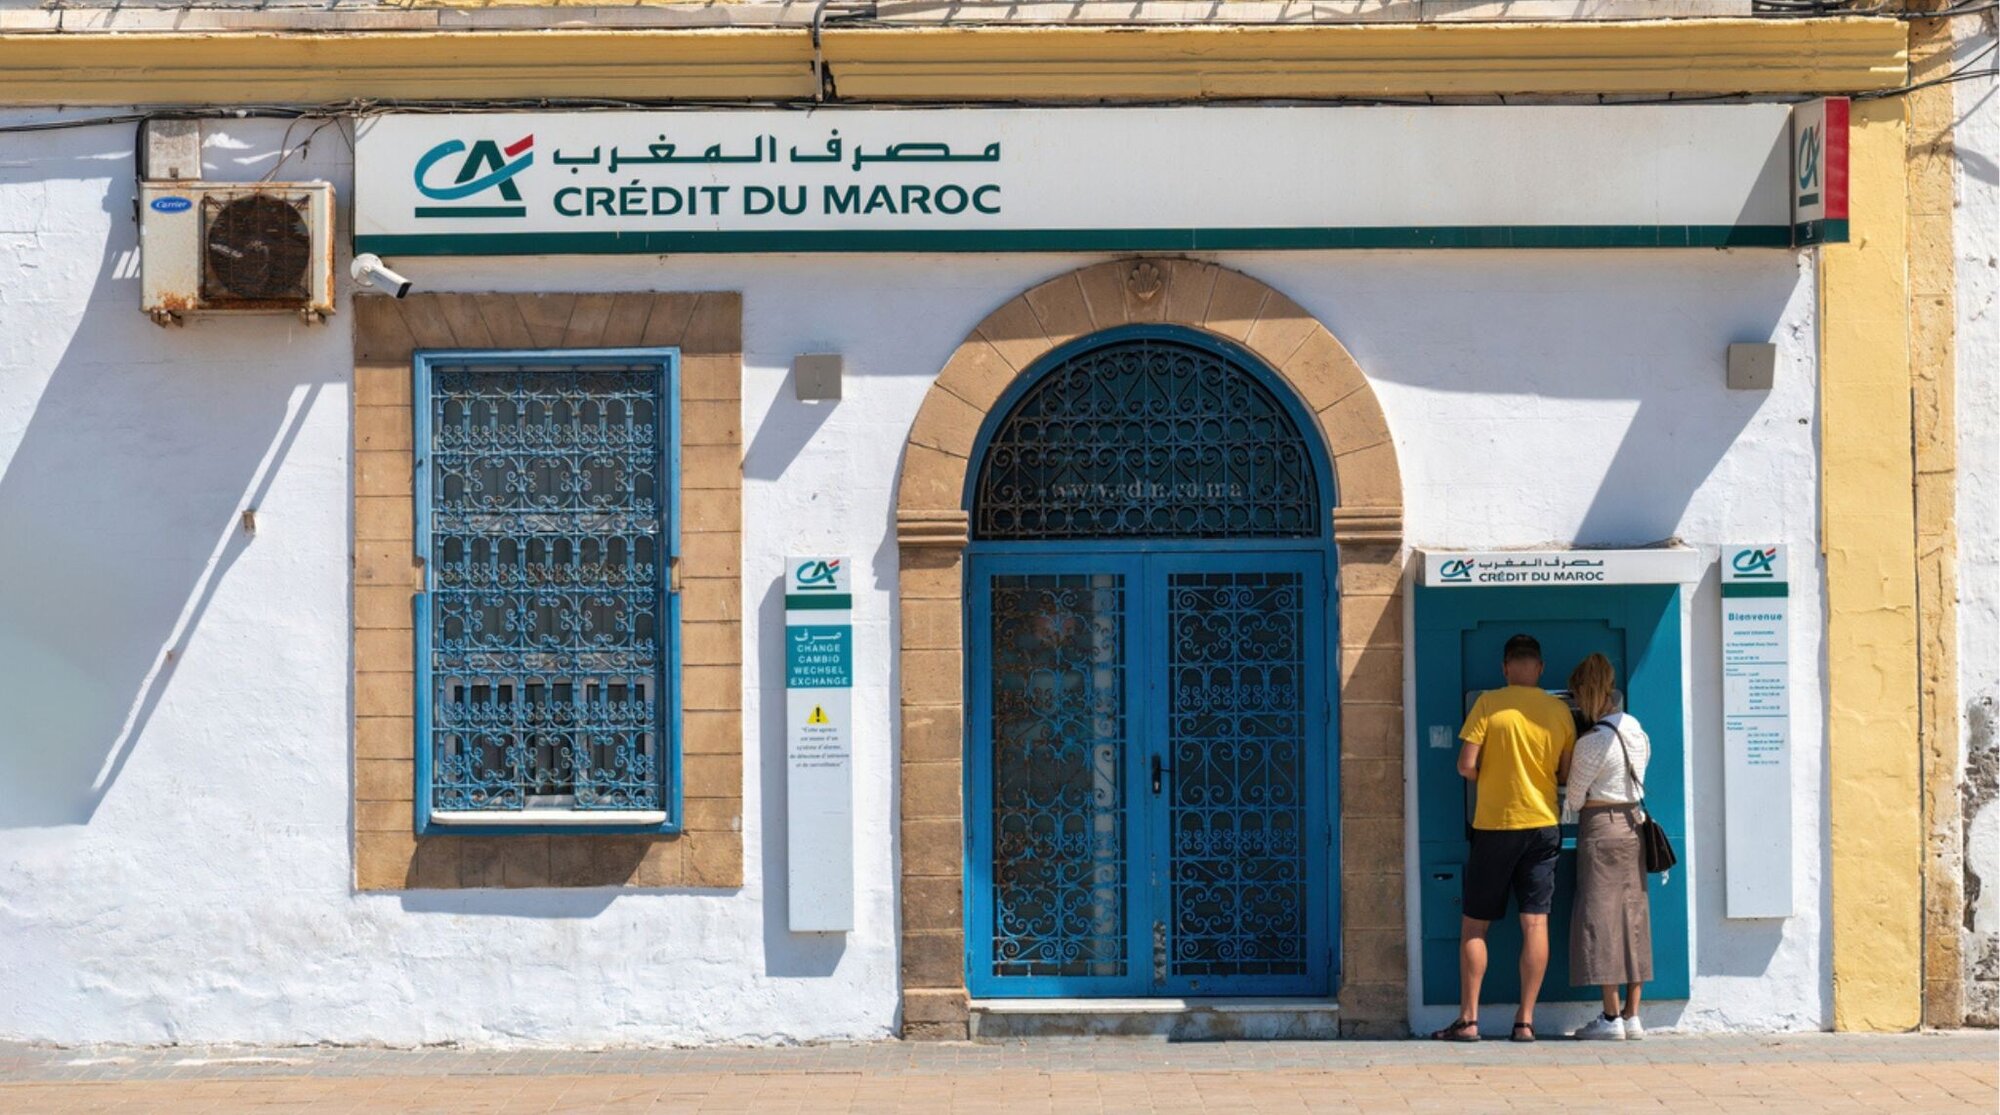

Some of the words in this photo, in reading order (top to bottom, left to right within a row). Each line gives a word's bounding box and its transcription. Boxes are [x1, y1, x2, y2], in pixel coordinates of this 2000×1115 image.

[553, 134, 777, 174] المغرب
[790, 128, 1000, 172] مصرف
[553, 179, 730, 217] CRÉDIT
[743, 185, 807, 215] DU
[823, 183, 1001, 215] MAROC
[156, 201, 188, 209] Carrier
[1479, 558, 1542, 569] المغرب
[1545, 556, 1605, 569] مصرف
[1478, 570, 1529, 582] CRÉDIT
[1531, 573, 1550, 582] DU
[1553, 571, 1605, 581] MAROC
[1728, 612, 1783, 621] Bienvenue
[794, 628, 842, 645] صرف
[796, 644, 841, 653] CHANGE
[798, 655, 840, 664] CAMBIO
[793, 666, 845, 675] WECHSEL
[790, 677, 849, 686] EXCHANGE
